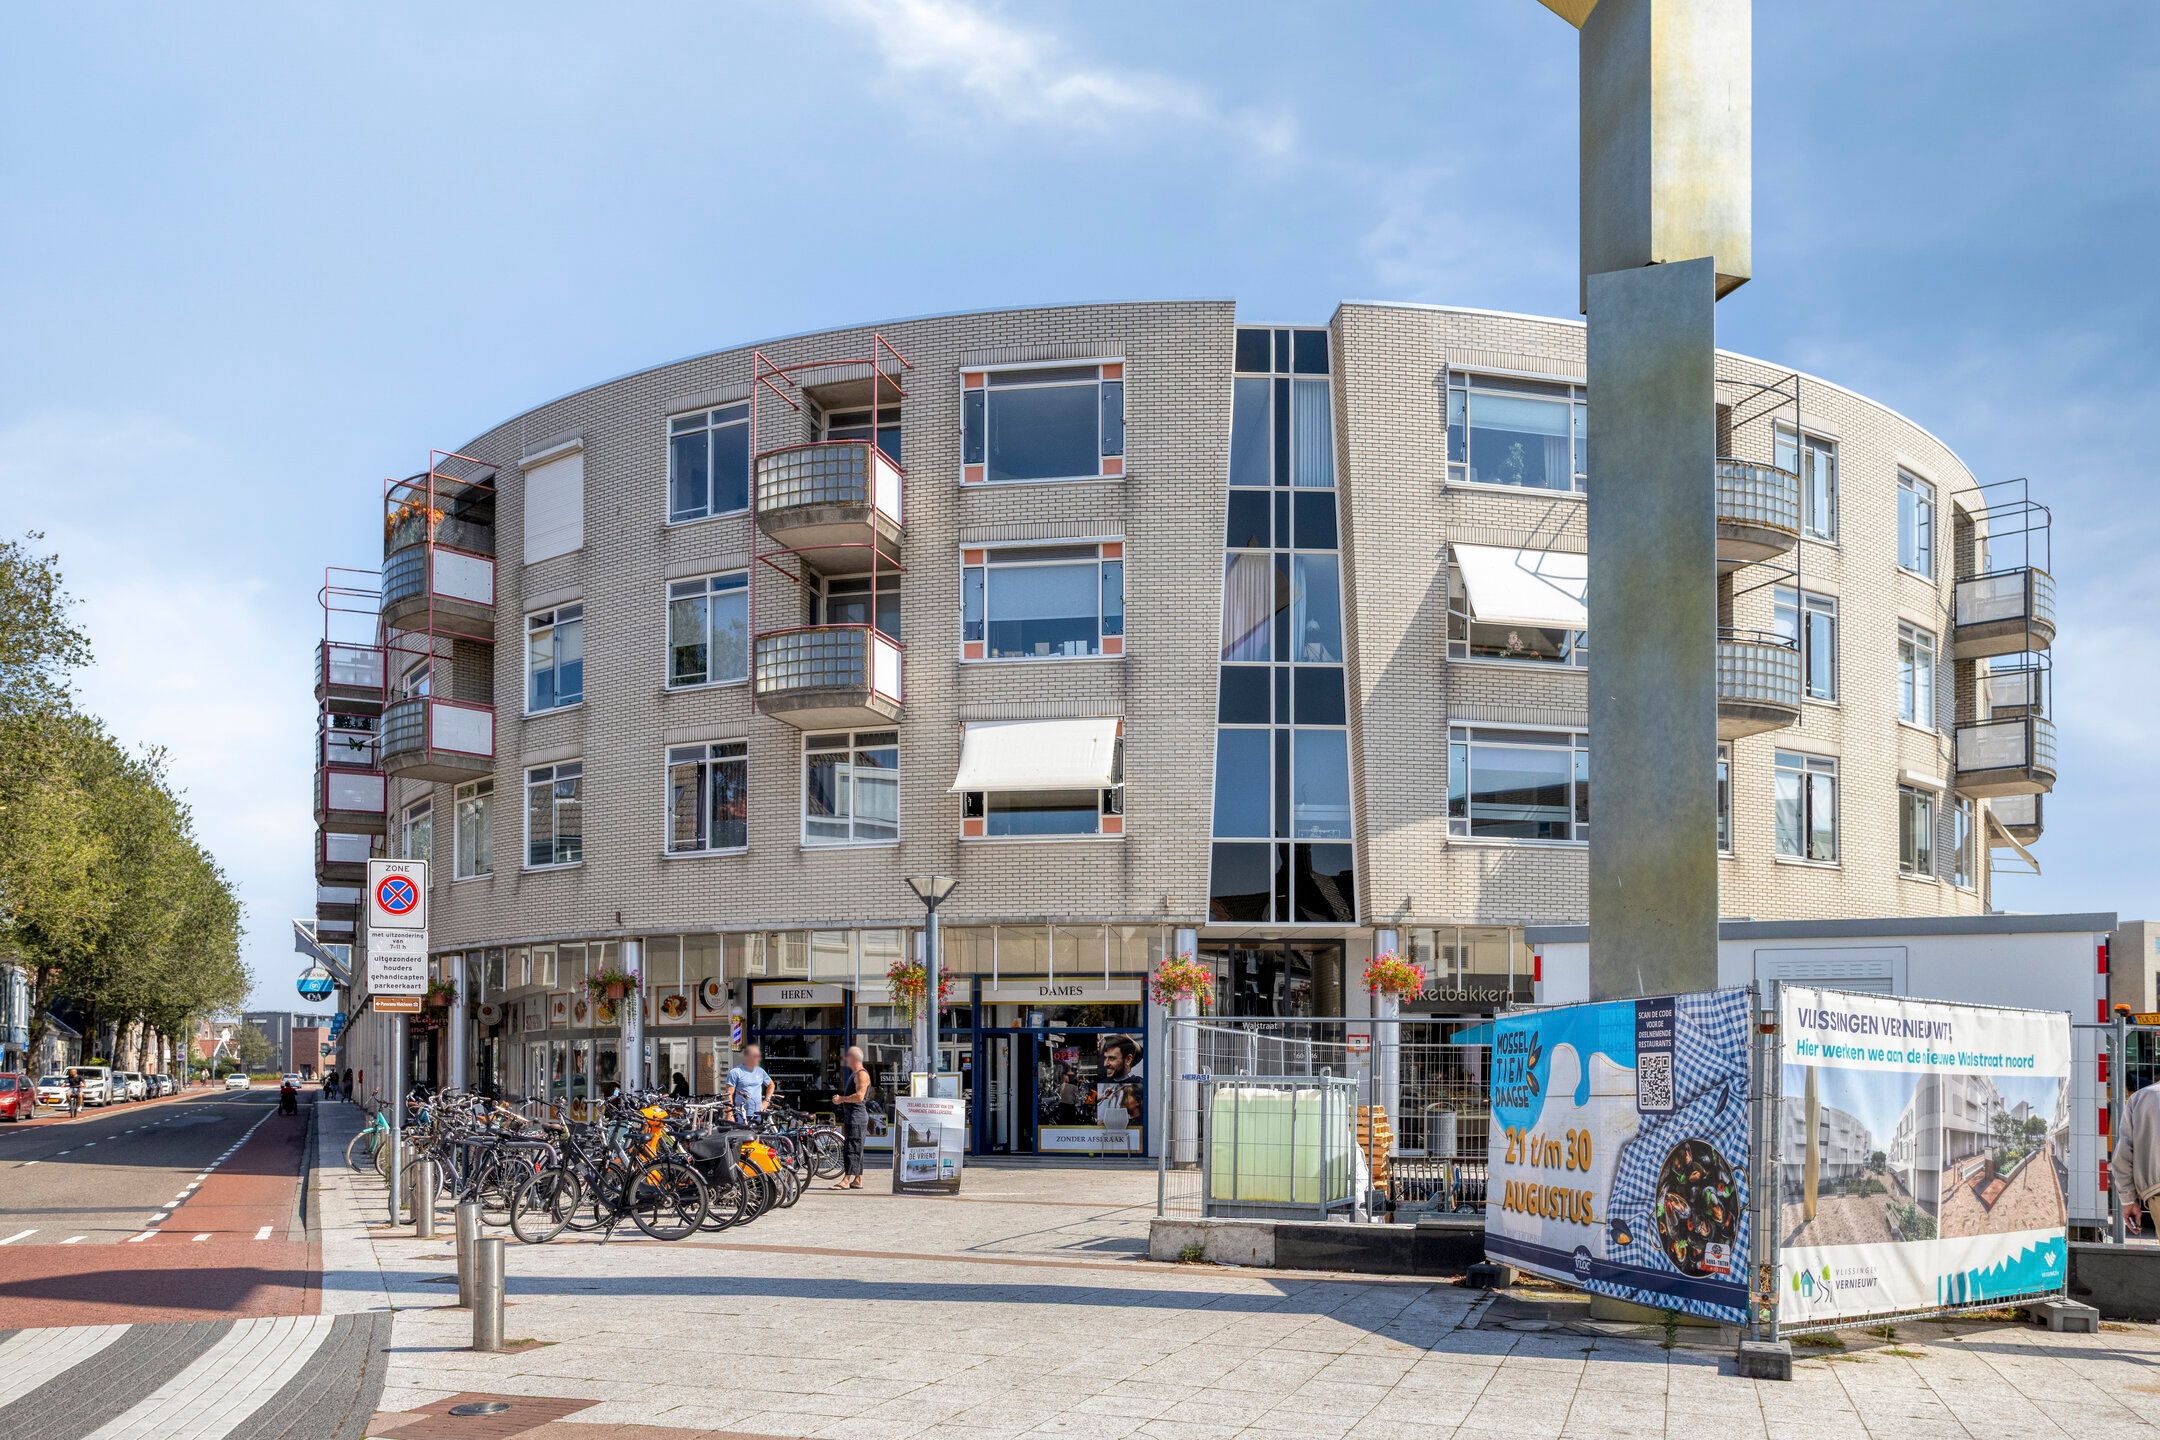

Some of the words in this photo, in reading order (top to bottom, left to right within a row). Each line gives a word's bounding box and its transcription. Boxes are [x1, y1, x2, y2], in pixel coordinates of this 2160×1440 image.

[385, 864, 410, 873] ZONE
[385, 932, 424, 940] uitzondering
[373, 955, 422, 963] uitgezonderd
[374, 982, 422, 990] parkeerkaart
[1039, 986, 1083, 996] DAMES
[781, 989, 814, 1000] HEREN
[1638, 1011, 1651, 1020] SCAN
[1651, 1010, 1659, 1018] DE
[1658, 1009, 1672, 1018] CODE
[1242, 1022, 1278, 1030] Walstraat
[1645, 1020, 1658, 1028] VOOR
[1657, 1020, 1664, 1028] DE
[1797, 1007, 1879, 1035] VLISSINGEN
[1881, 1016, 1953, 1042] VERNIEUWT!
[1638, 1029, 1672, 1039] DEELNEMENDE
[1496, 1030, 1529, 1055] MOSSEL
[1638, 1039, 1672, 1049] RESTAURANTS
[1796, 1039, 1819, 1057] Hier
[1822, 1043, 1865, 1061] werken
[1867, 1048, 1885, 1062] we
[1886, 1050, 1903, 1063] aan
[1906, 1047, 1921, 1064] de
[1922, 1048, 1955, 1066] nieuwe
[1957, 1051, 2003, 1068] Walstraat
[2005, 1054, 2035, 1069] noord
[1496, 1057, 1524, 1083] TIEN
[1495, 1085, 1530, 1109] DAAGSE
[1056, 1135, 1086, 1143] ZONDER
[1505, 1126, 1526, 1165] 21
[1531, 1132, 1563, 1169] t/m
[1566, 1128, 1593, 1173] 30
[1502, 1179, 1594, 1226] AUGUSTUS
[1574, 1259, 1591, 1271] VLOC
[1835, 1277, 1878, 1290] VERNIEUWT
